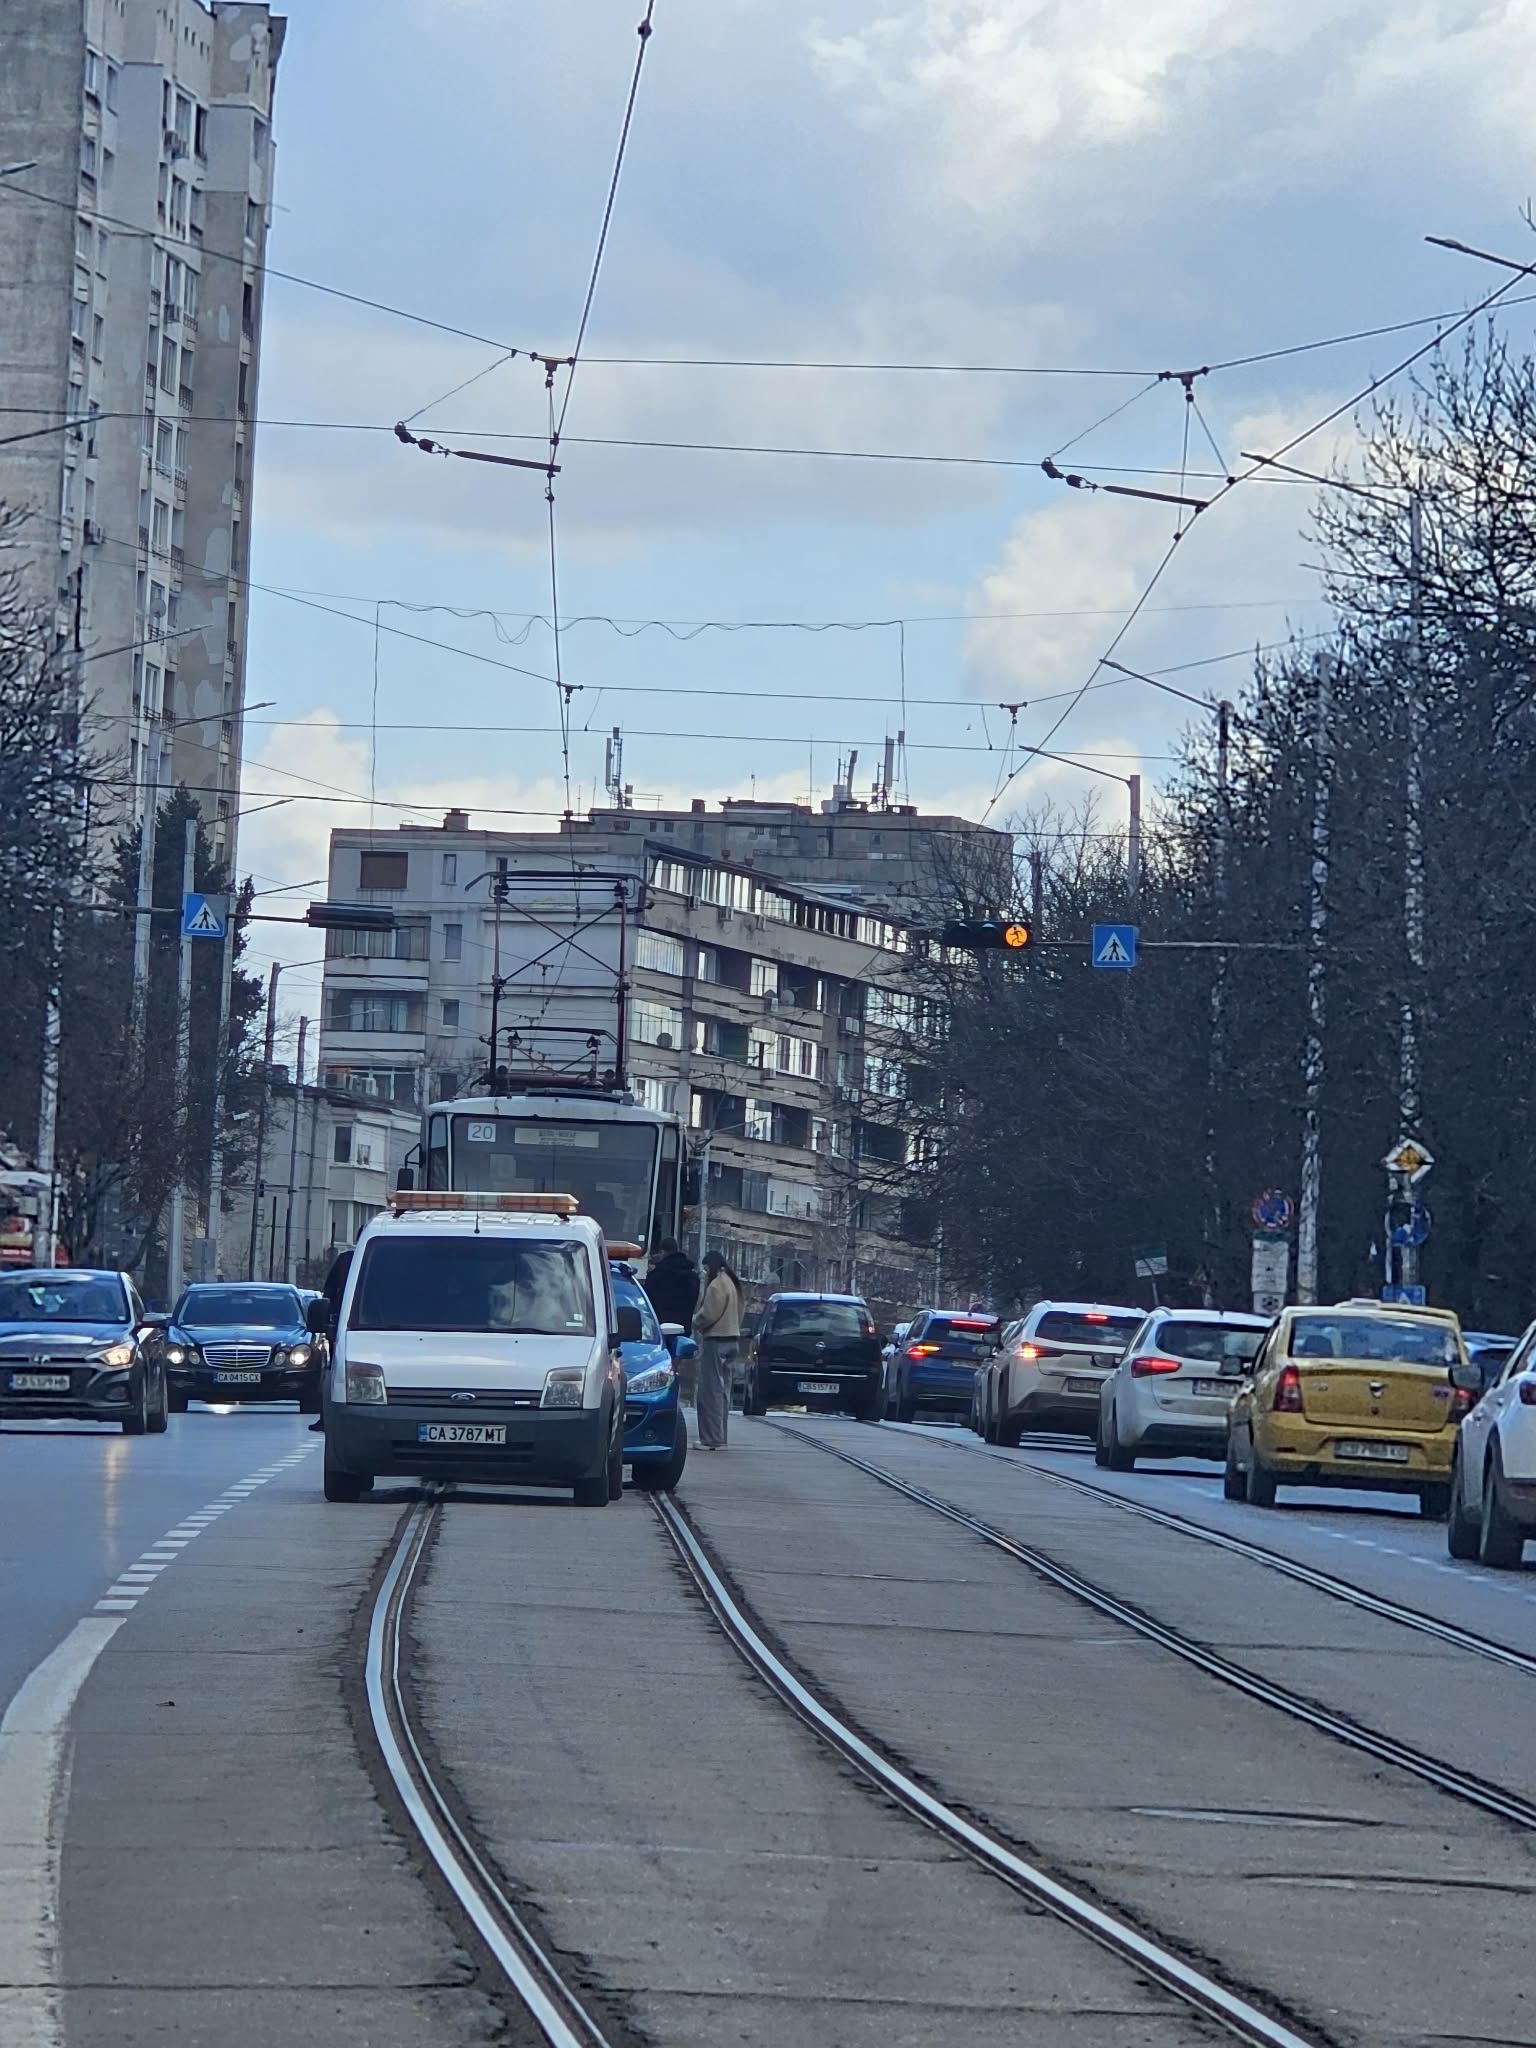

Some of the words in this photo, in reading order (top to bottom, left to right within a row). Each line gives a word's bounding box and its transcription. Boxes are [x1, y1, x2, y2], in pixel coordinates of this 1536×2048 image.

[471, 1124, 493, 1140] 20
[428, 1427, 446, 1441] CA
[449, 1427, 483, 1442] 3787
[485, 1428, 504, 1442] MT
